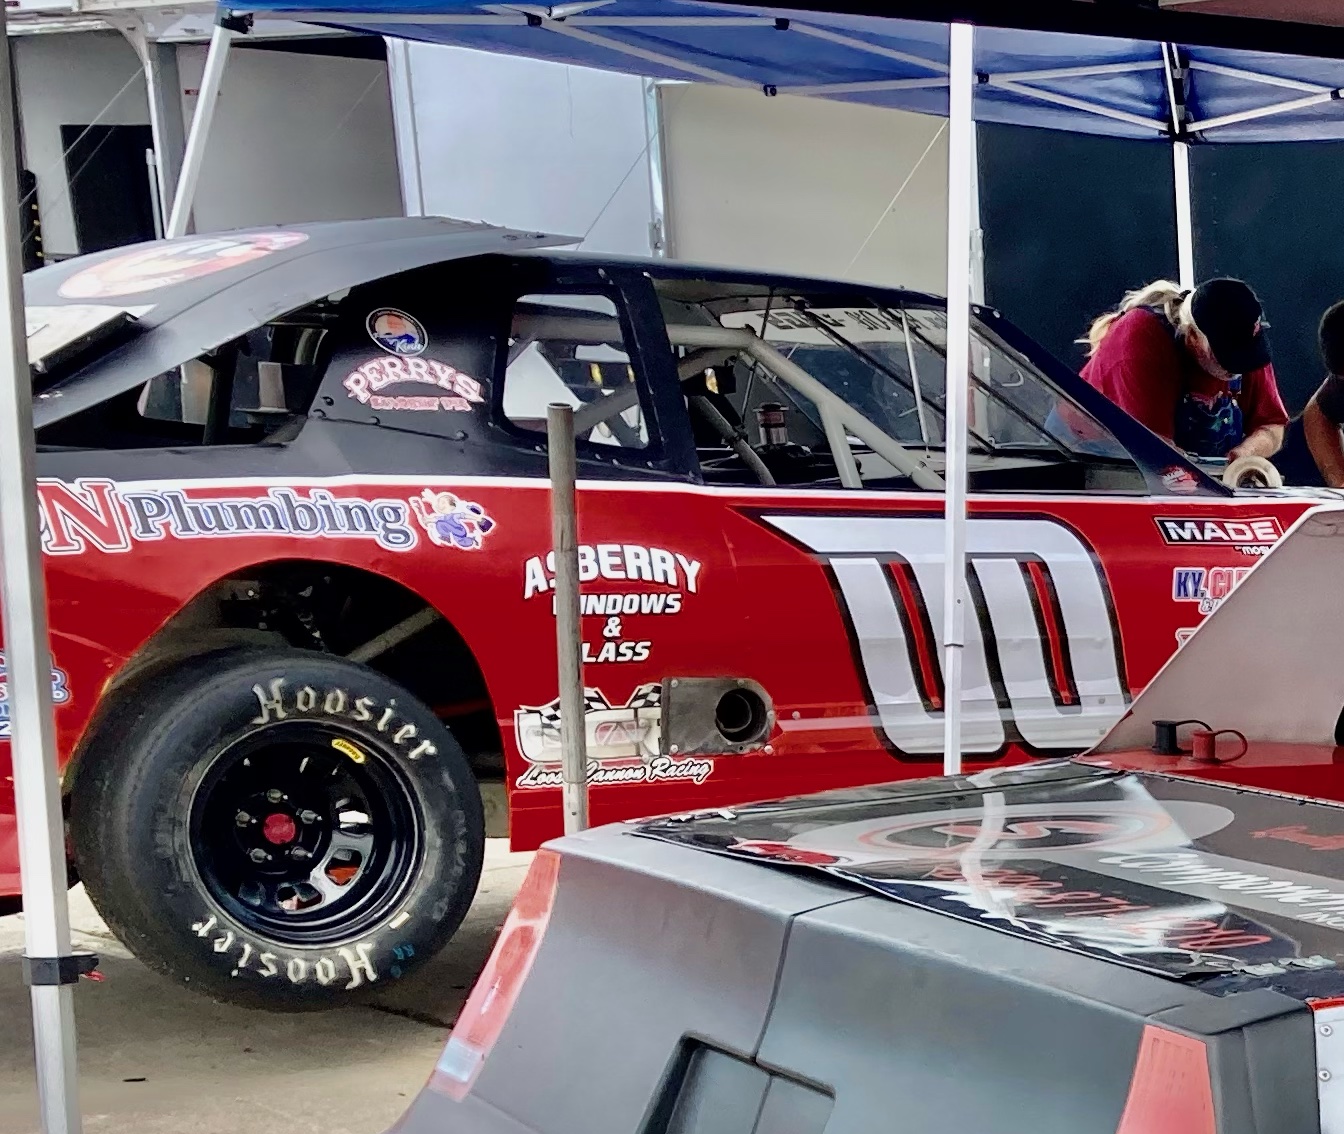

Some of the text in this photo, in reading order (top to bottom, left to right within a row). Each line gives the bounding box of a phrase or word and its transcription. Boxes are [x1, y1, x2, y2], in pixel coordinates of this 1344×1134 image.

[345, 357, 485, 403] PERRYS
[126, 490, 408, 546] Plumbing
[1164, 521, 1278, 540] MADE
[553, 594, 682, 614] INDOWS
[603, 617, 622, 637] &
[582, 641, 651, 662] LASS
[251, 677, 437, 760] Hoosier
[650, 757, 712, 783] Racing
[192, 915, 379, 990] Hoosier
